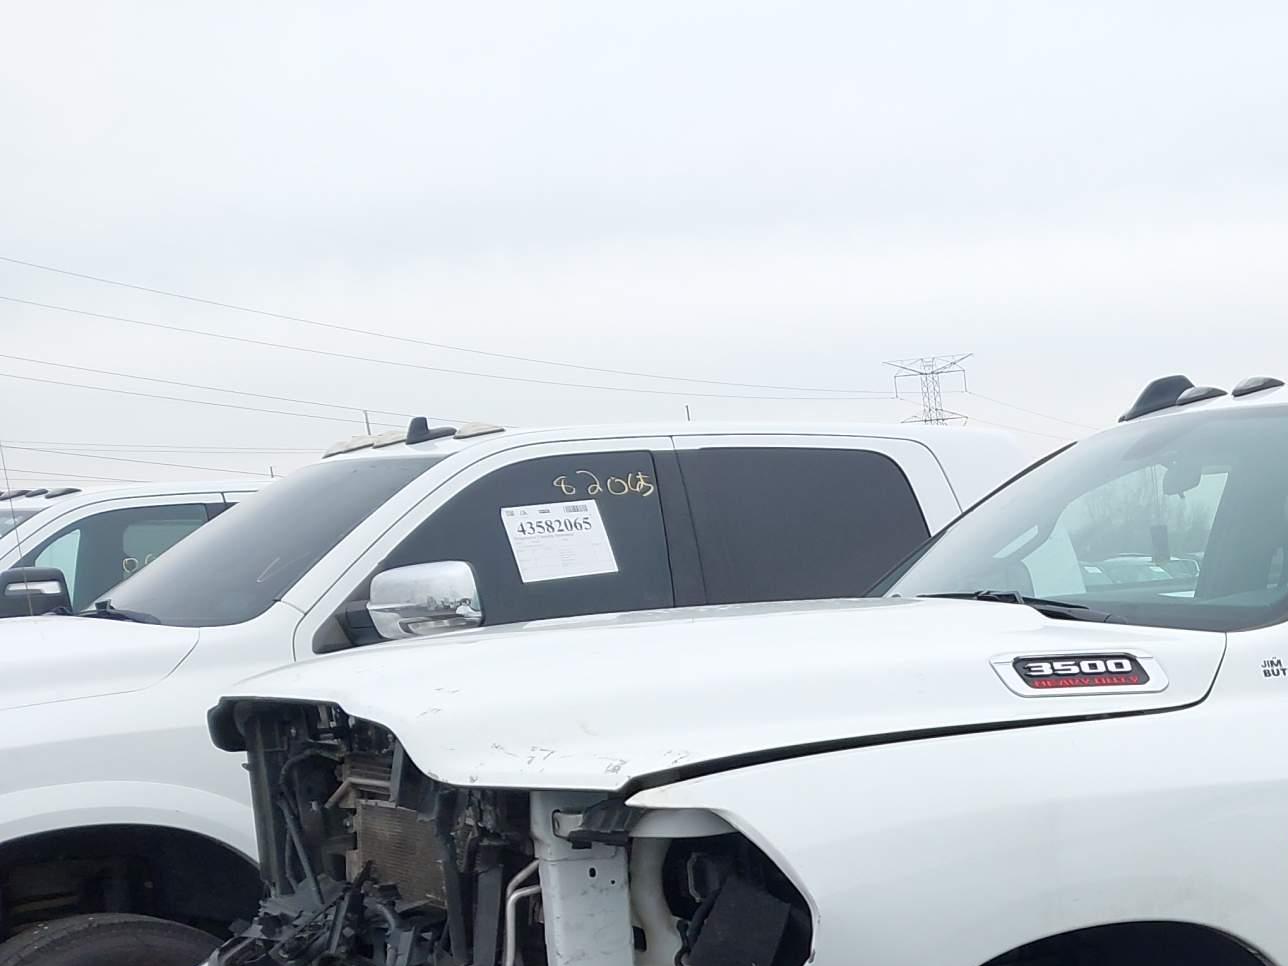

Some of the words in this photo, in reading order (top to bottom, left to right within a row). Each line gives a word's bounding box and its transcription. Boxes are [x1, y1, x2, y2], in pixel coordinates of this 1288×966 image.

[517, 517, 592, 535] 43582065
[1025, 659, 1132, 675] 3500
[1261, 659, 1282, 668] JIM
